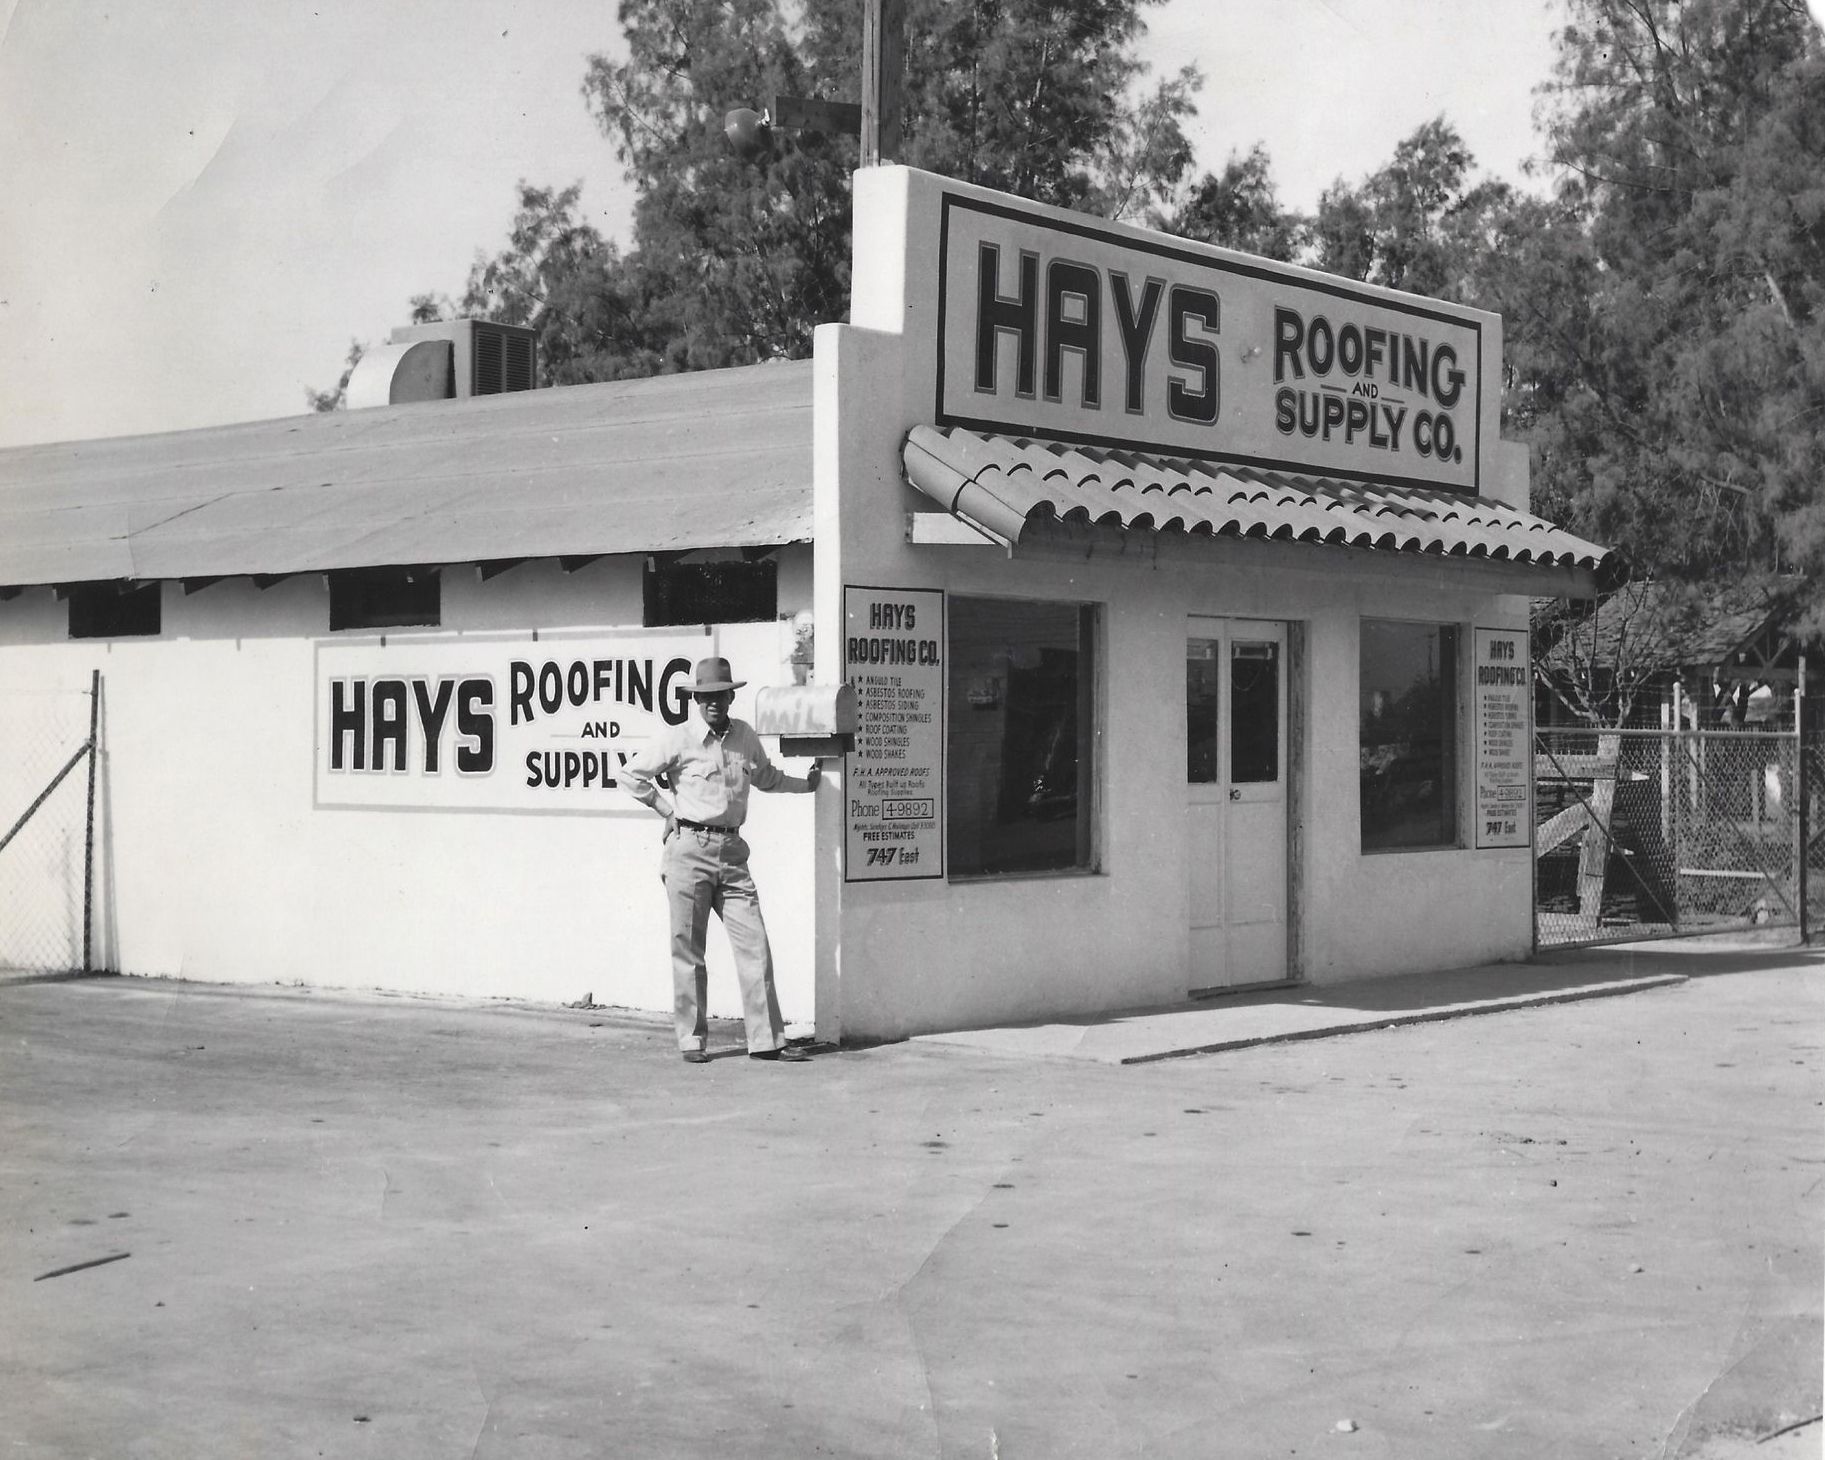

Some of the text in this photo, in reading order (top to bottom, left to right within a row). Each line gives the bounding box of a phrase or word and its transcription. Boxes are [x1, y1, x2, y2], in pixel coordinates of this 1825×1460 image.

[974, 240, 1221, 426] HAYS
[1273, 305, 1466, 410] ROOFING
[1352, 382, 1379, 398] AND
[1275, 386, 1462, 464] SUPPLY CO.
[870, 603, 915, 630] HAYS
[848, 637, 940, 666] ROOFING CO.
[1490, 640, 1515, 660] HAYS
[510, 657, 693, 726] ROOFING
[866, 687, 925, 699] ASBESTOS ROOFING
[866, 700, 919, 711] ASBESTOS SIDING
[330, 676, 496, 776] HAYS
[866, 712, 932, 723] COMPOSITION SHINGLES
[581, 721, 621, 738] AND
[866, 724, 907, 734] ROOF COATING
[866, 737, 910, 747] WOOD SHINGLES
[866, 749, 906, 759] WOOD SHAKES
[875, 768, 909, 777] APPROVED
[909, 768, 930, 777] ROOFS
[851, 800, 929, 817] Phone 4-9892
[863, 831, 915, 842] FREE ESTIMATES
[1486, 821, 1503, 836] 747
[867, 847, 920, 867] 747 East
